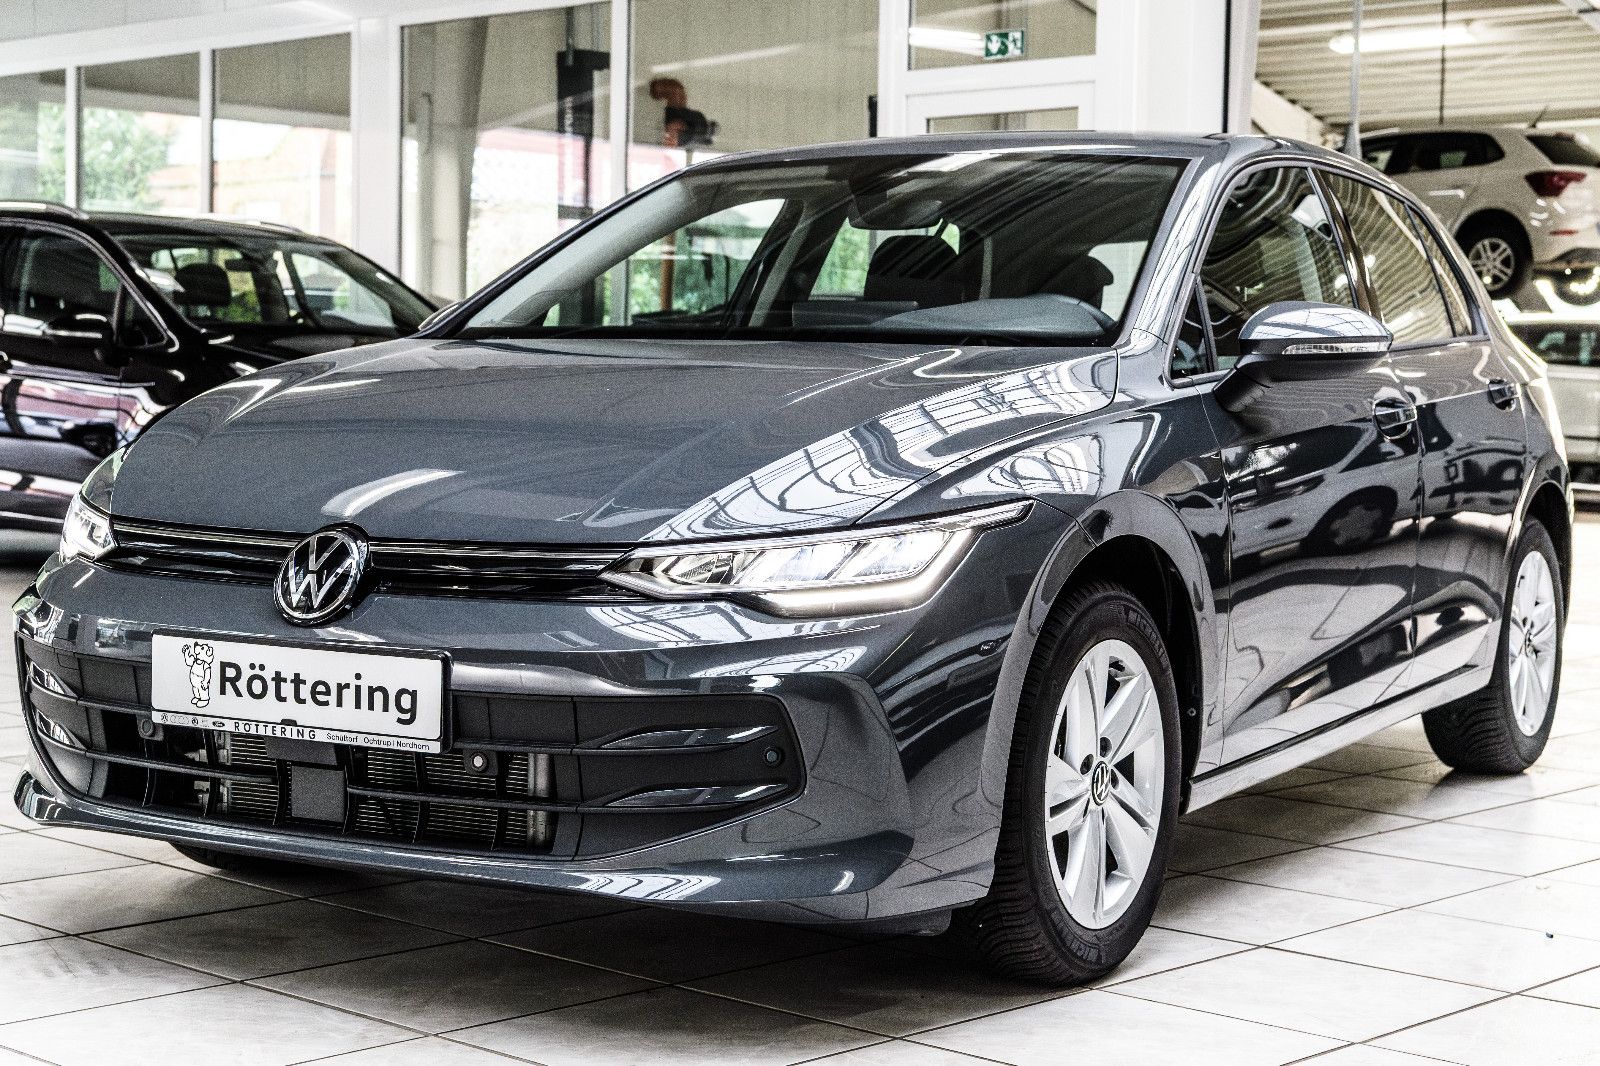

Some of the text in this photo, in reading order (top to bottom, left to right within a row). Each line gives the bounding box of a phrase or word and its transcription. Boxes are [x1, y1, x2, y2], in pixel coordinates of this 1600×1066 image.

[219, 660, 418, 726] Röttering
[234, 721, 316, 740] RÖTTERING
[363, 736, 392, 747] Ochtrup
[396, 740, 430, 751] Nordhorn
